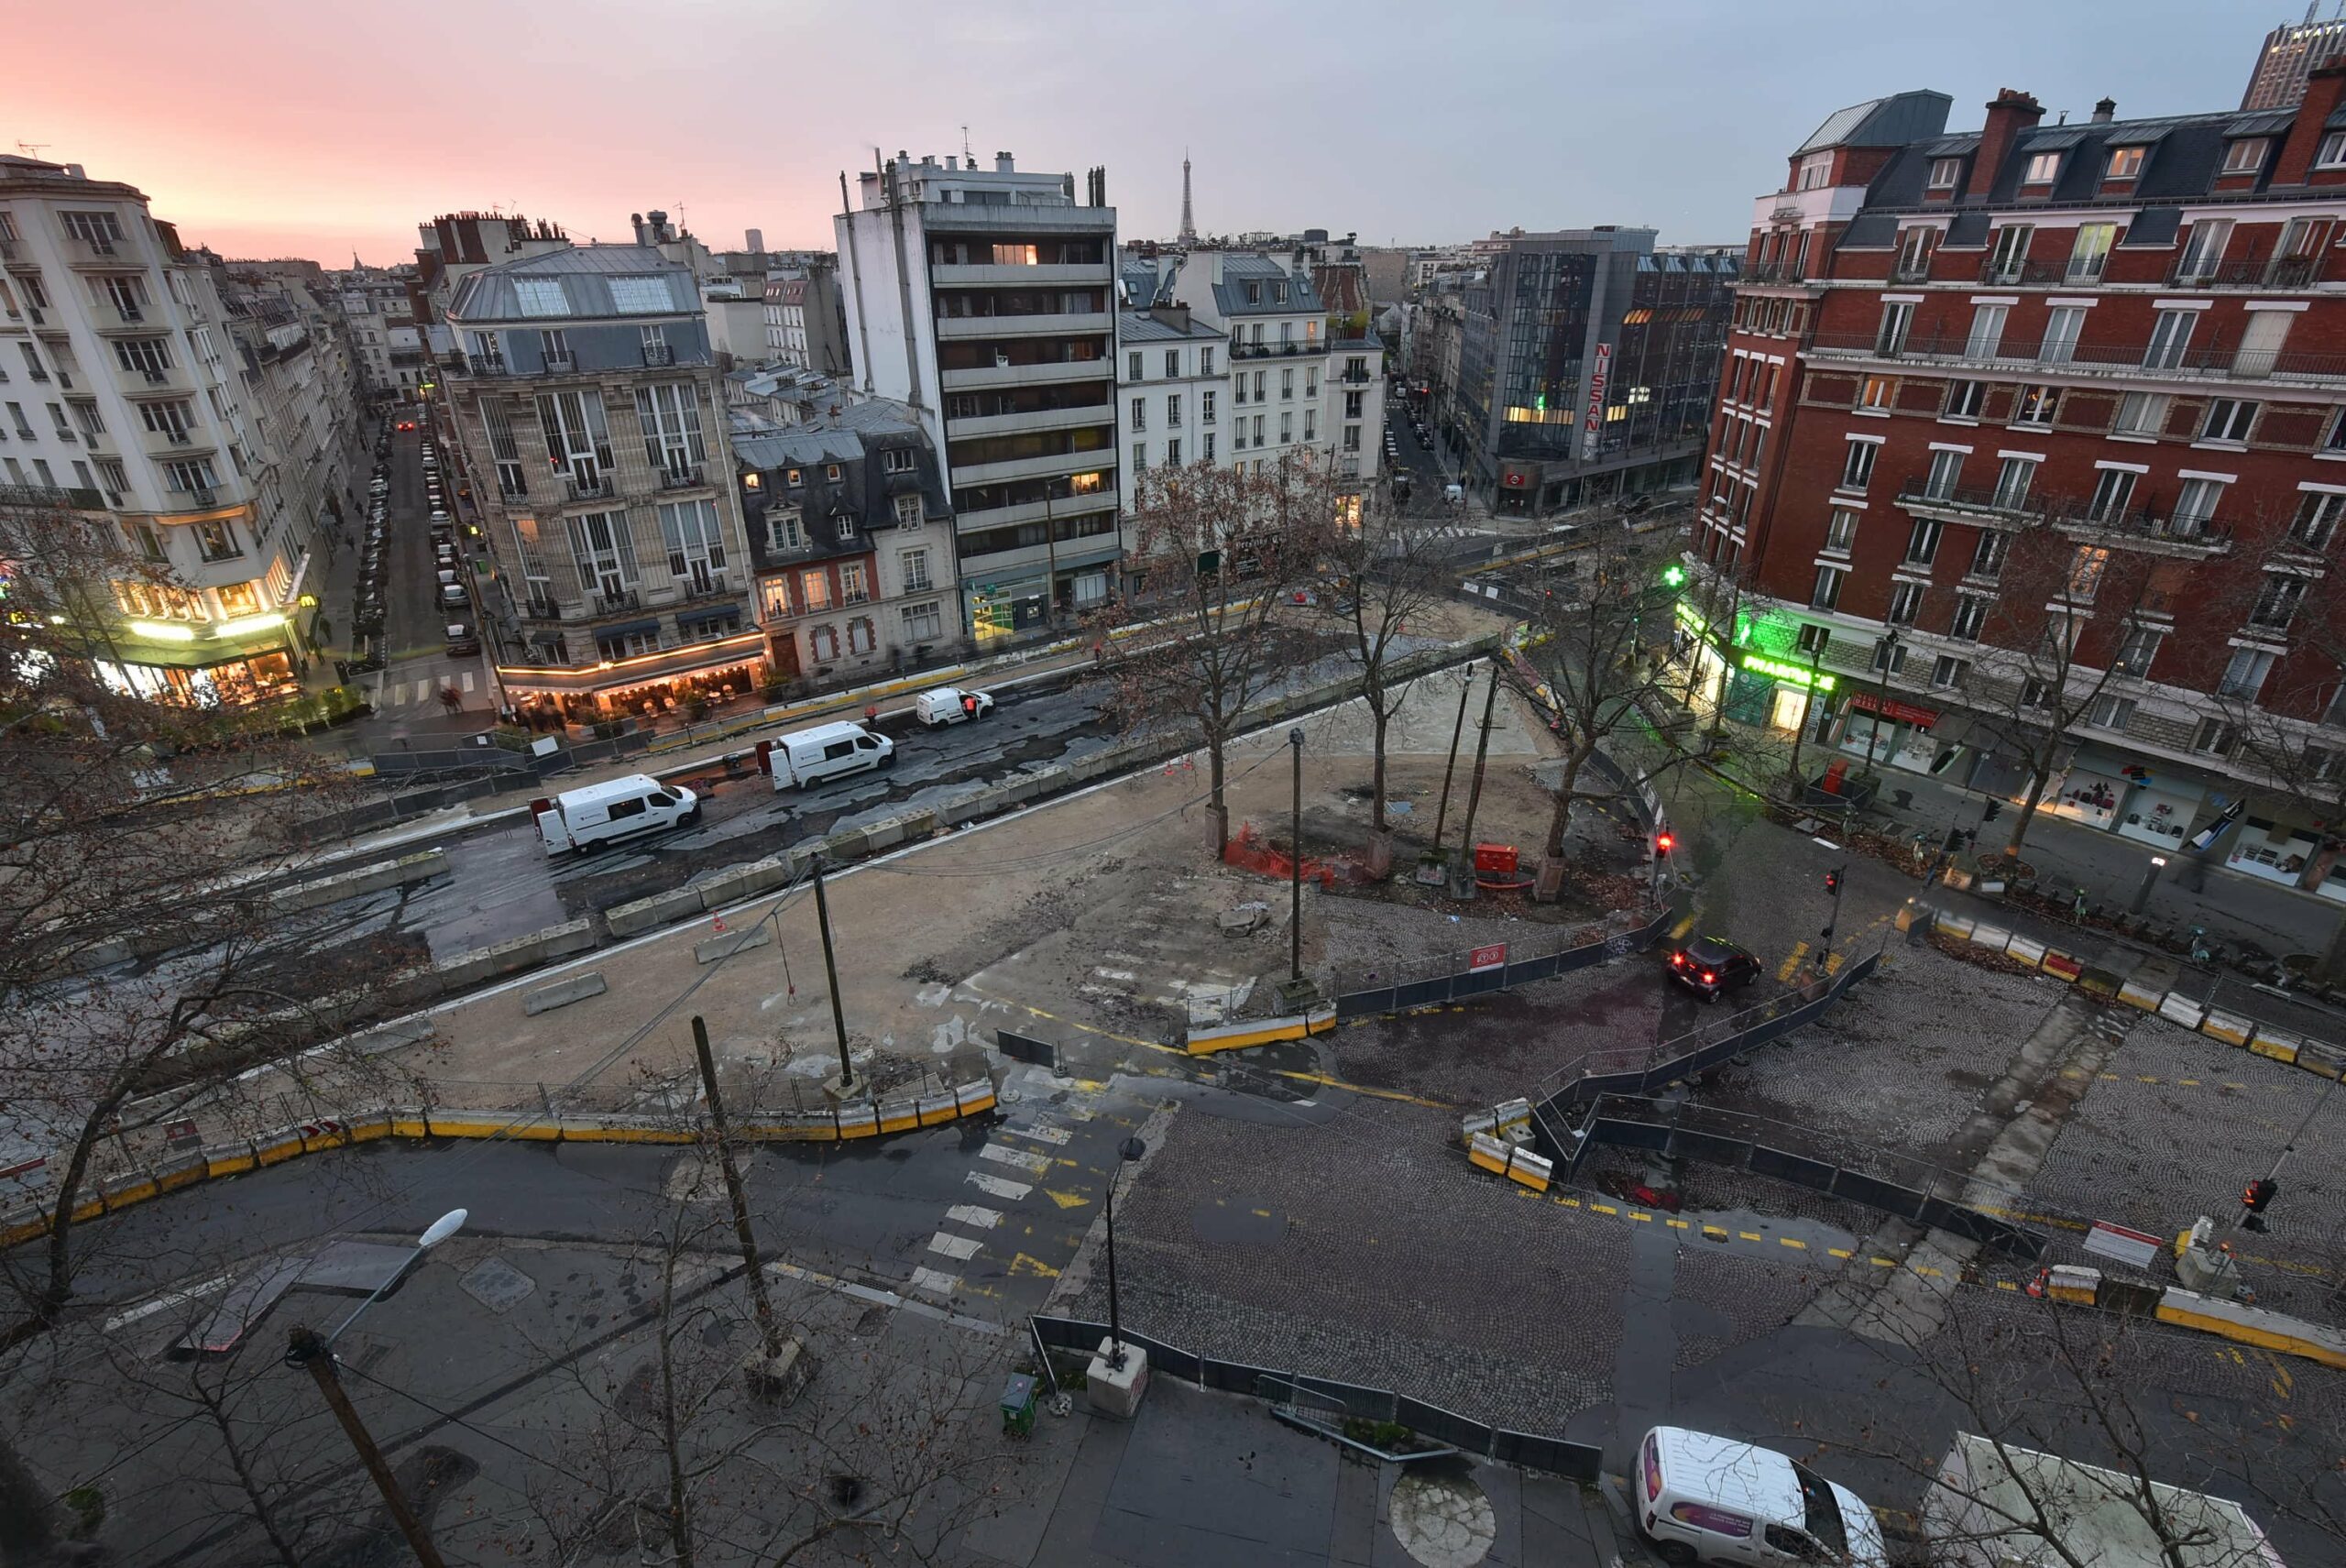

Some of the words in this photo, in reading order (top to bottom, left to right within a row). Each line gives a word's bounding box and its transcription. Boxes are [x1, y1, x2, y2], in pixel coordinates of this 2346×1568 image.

[1585, 344, 1611, 431] NISSAN
[1855, 697, 1889, 712] DESSN
[1857, 693, 1891, 707] NEUILY
